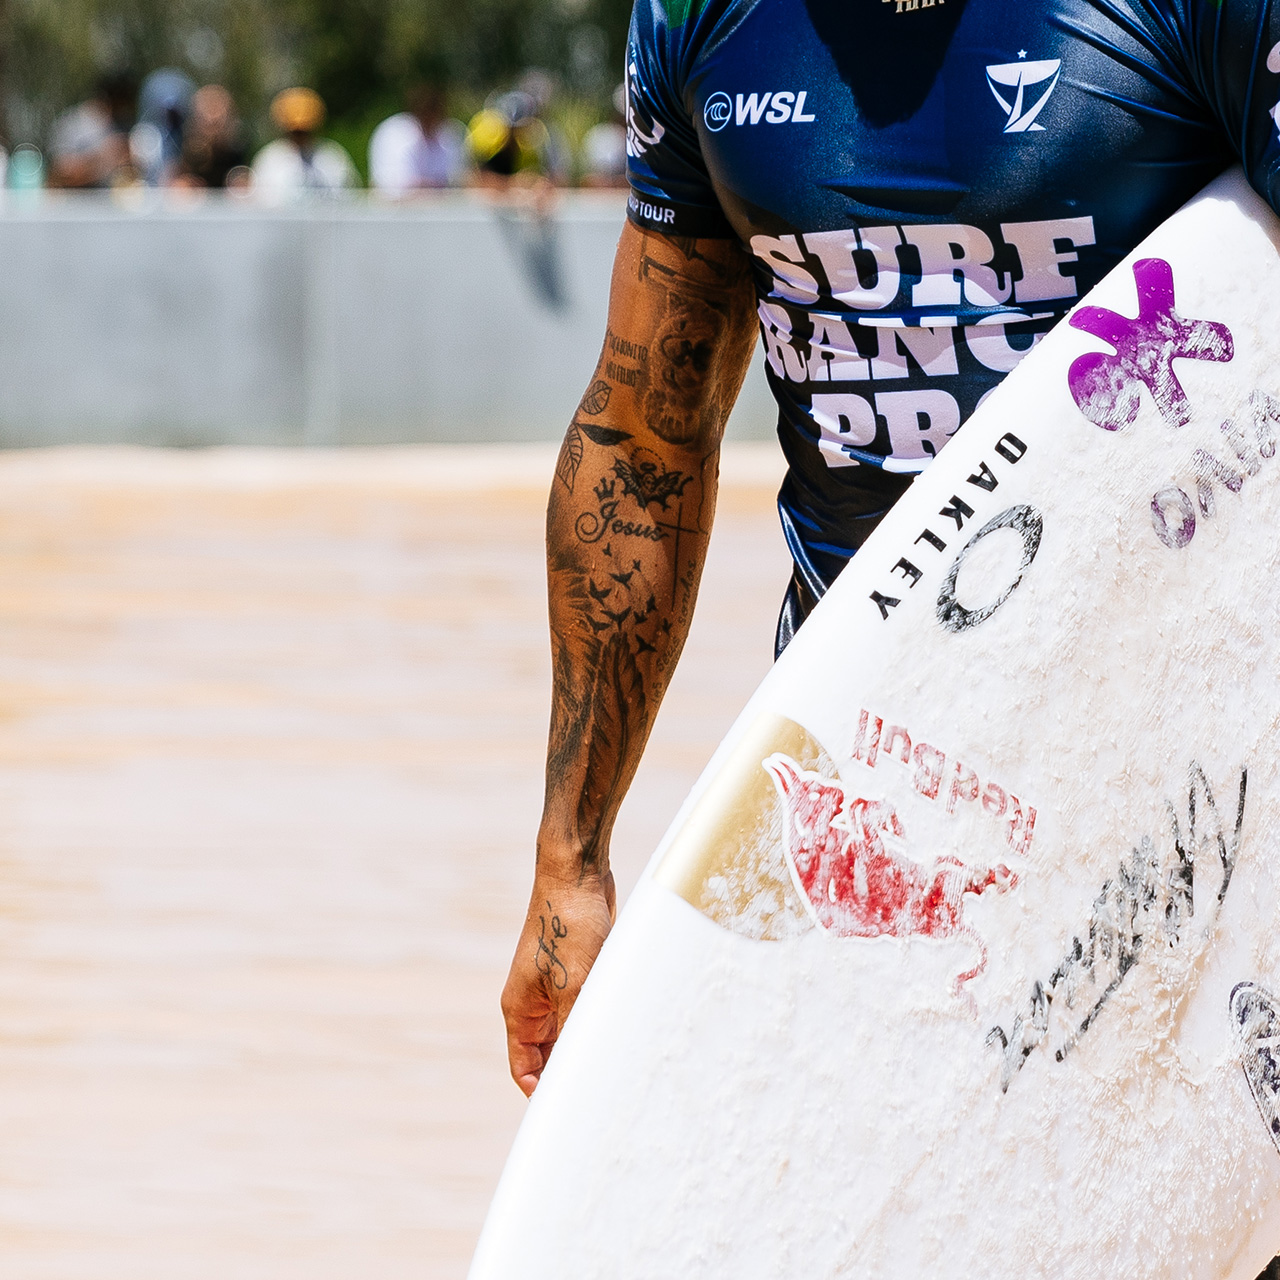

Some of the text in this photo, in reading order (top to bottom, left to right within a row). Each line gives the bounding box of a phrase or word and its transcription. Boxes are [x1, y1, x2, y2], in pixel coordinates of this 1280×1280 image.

[735, 91, 816, 126] WSL
[639, 201, 676, 224] TOUR
[749, 215, 1096, 310] SURF
[757, 298, 1070, 383] RANC
[808, 388, 998, 475] PR
[575, 500, 670, 544] Jesus
[869, 431, 1028, 621] OAKLEY
